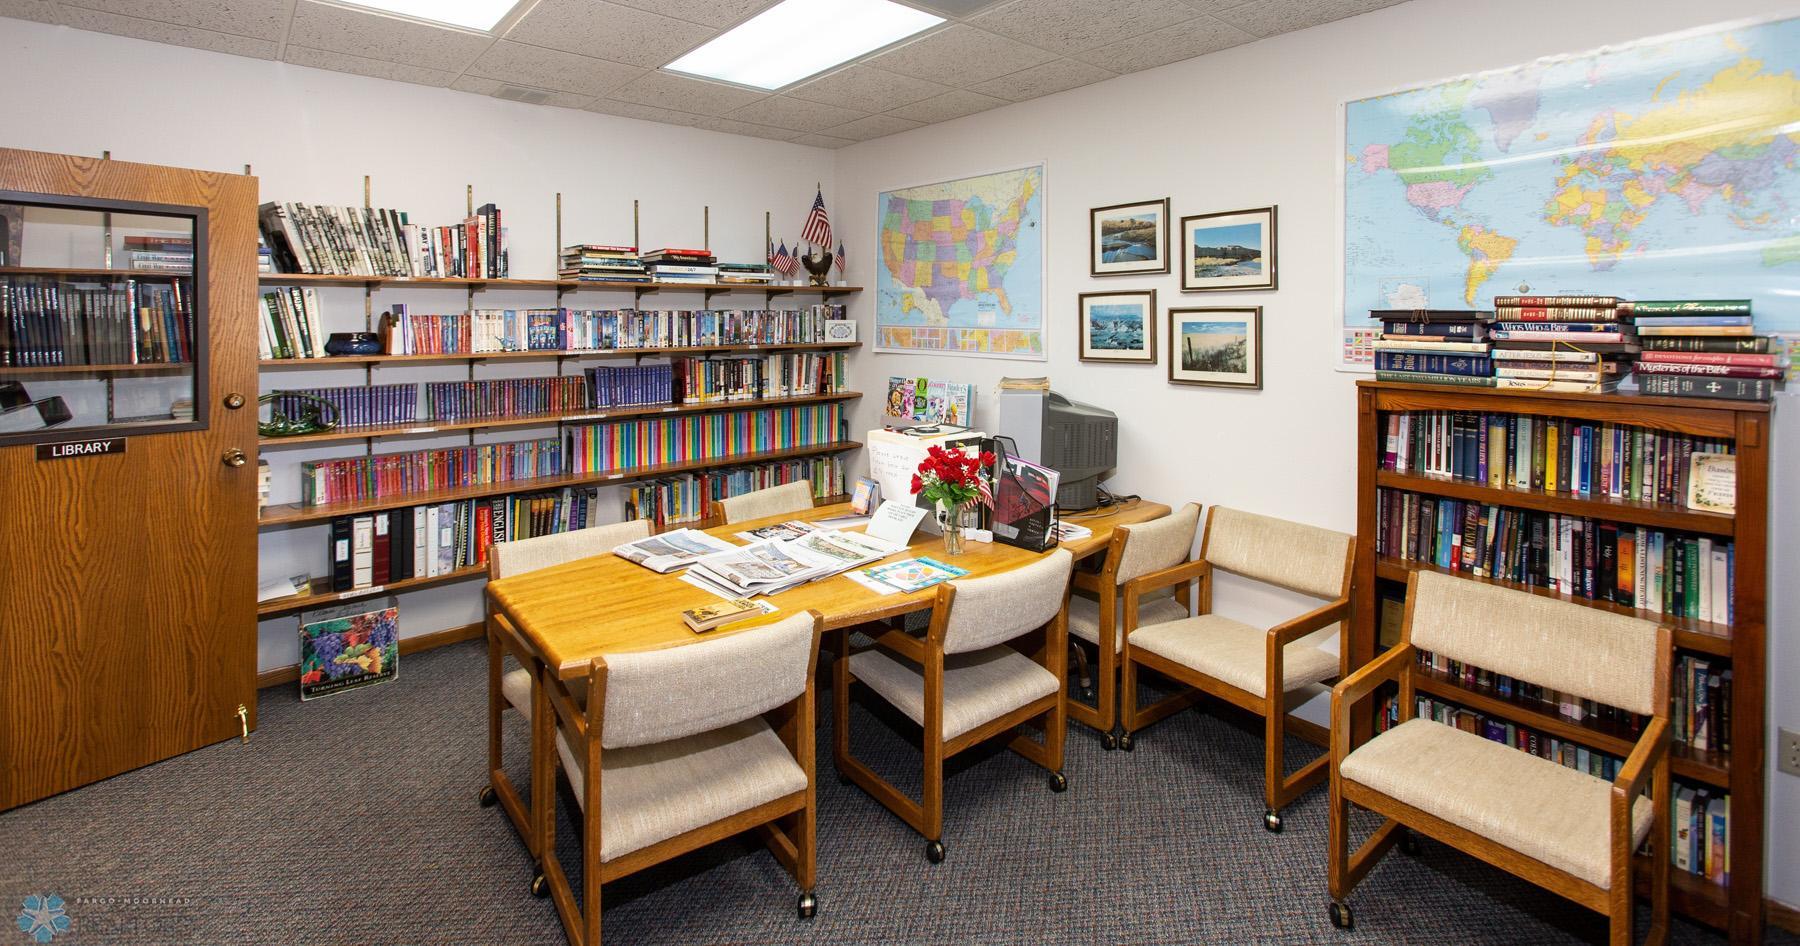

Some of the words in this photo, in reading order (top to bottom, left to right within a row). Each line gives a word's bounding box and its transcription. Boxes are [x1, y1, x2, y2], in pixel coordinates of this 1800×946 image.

[1639, 363, 1680, 374] Mysteries
[1706, 365, 1731, 375] Bible
[52, 441, 112, 458] LIBRARY
[493, 510, 505, 545] ENGLISH
